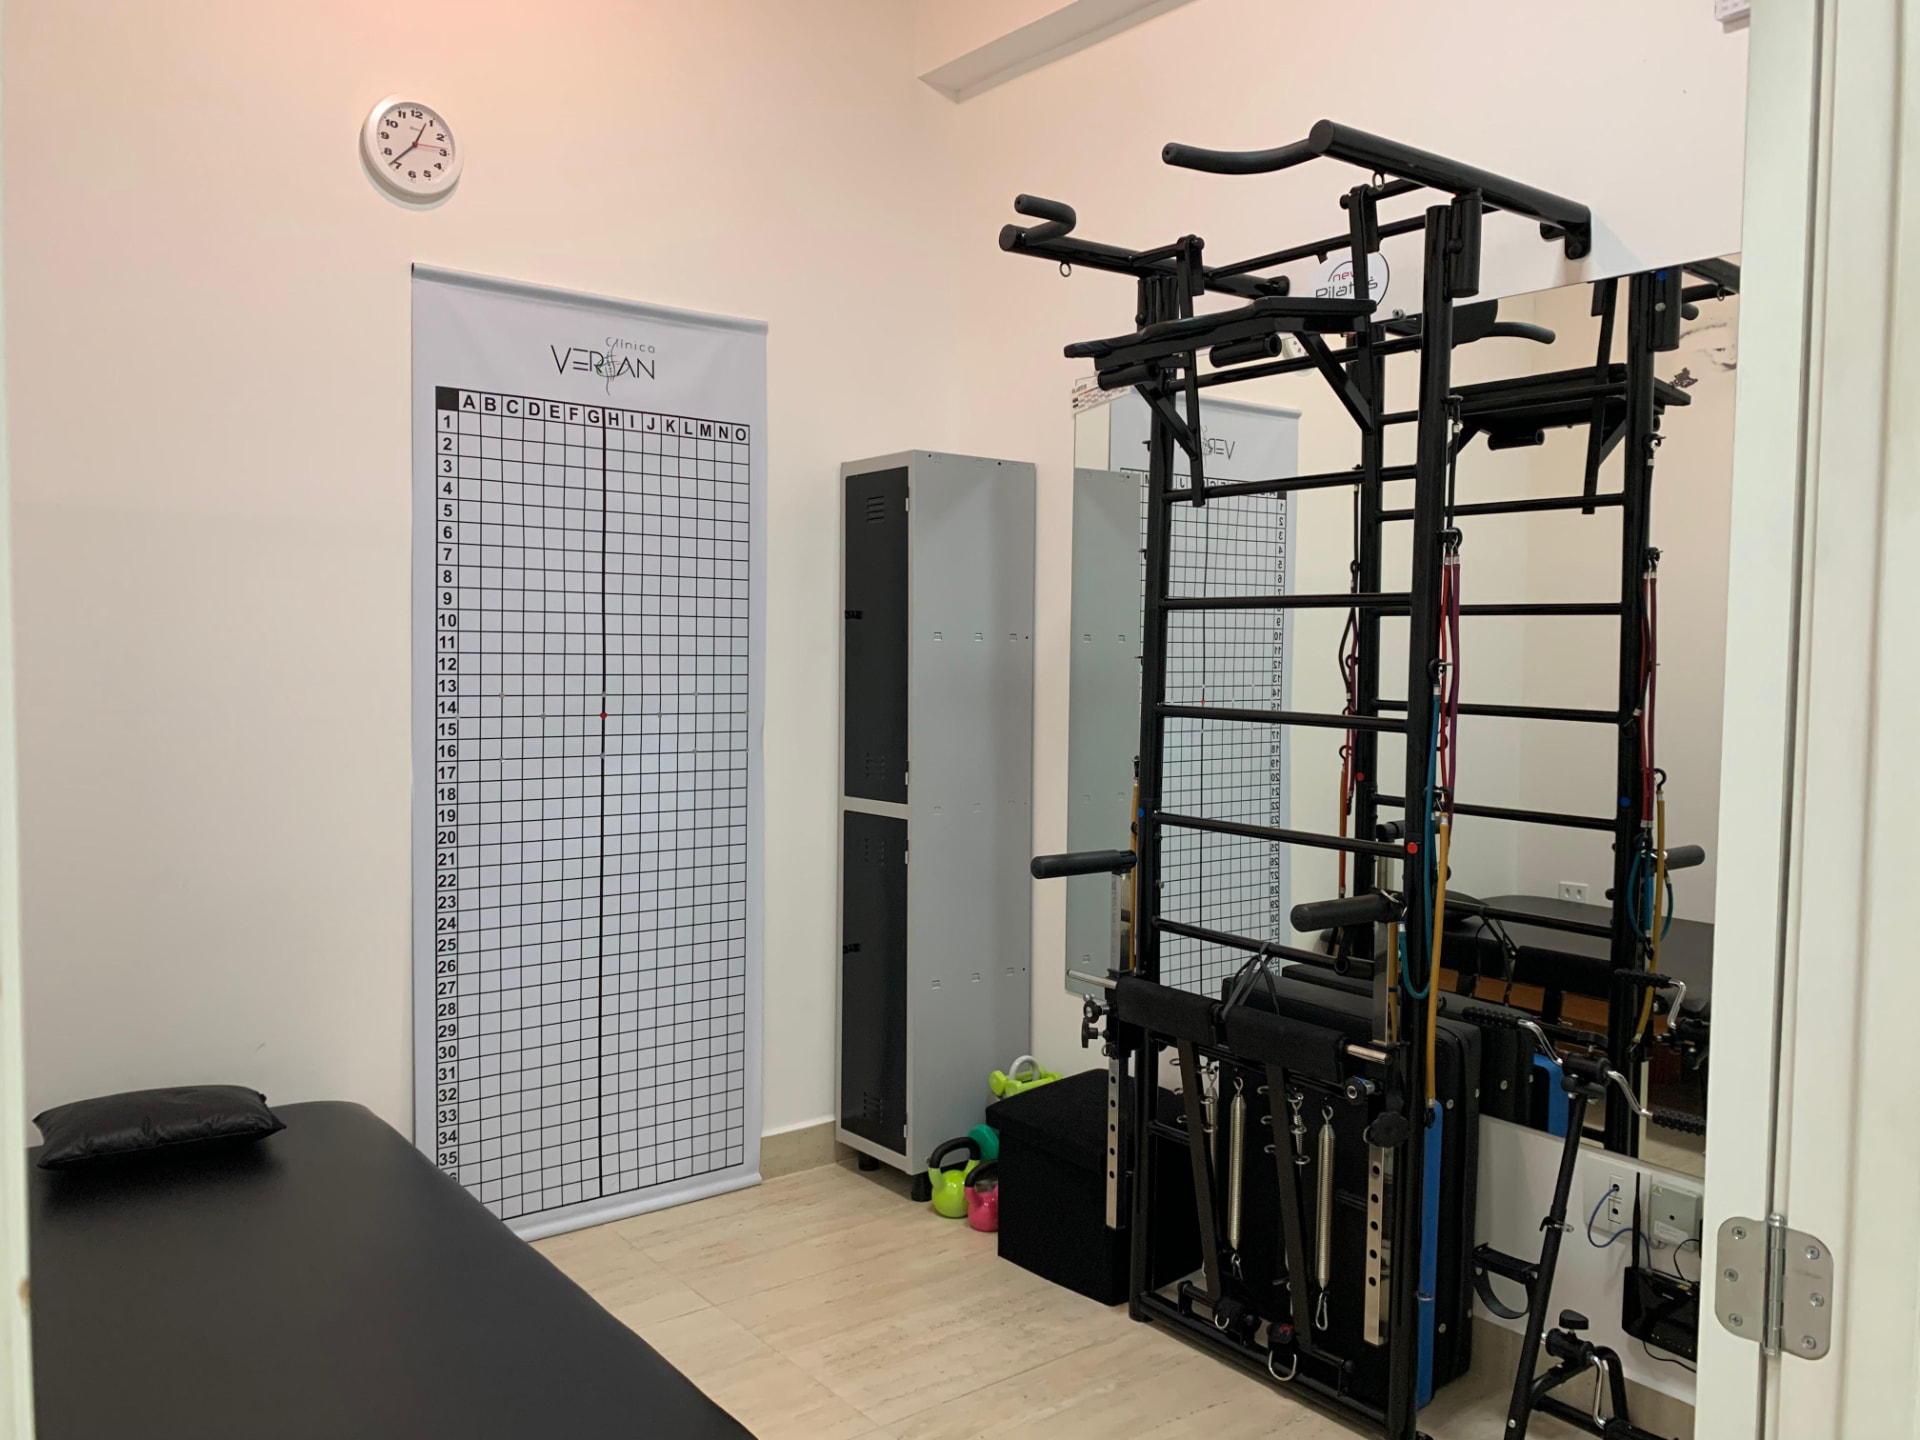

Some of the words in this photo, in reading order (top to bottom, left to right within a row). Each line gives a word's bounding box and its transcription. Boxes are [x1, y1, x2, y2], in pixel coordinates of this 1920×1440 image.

[398, 110, 406, 120] 11
[410, 109, 424, 120] 12
[385, 119, 398, 128] 10
[428, 120, 434, 128] 1
[380, 131, 390, 140] 9
[436, 133, 445, 142] 2
[384, 148, 392, 156] 8
[438, 148, 447, 157] 3
[394, 160, 402, 170] 7
[434, 162, 442, 170] 4
[408, 170, 416, 178] 6
[423, 170, 432, 178] 5
[1315, 278, 1378, 298] Pilats
[443, 414, 451, 429] 1
[462, 394, 476, 410] A
[484, 396, 497, 412] B
[506, 399, 519, 414] C
[528, 401, 541, 416] D
[549, 404, 561, 419] E
[569, 407, 579, 421] F
[587, 409, 600, 424] G
[608, 412, 619, 427] H
[646, 417, 655, 431] J
[666, 419, 676, 433] K
[684, 421, 693, 436] L
[700, 423, 712, 438] M
[718, 425, 729, 440] N
[735, 427, 747, 442] O
[442, 437, 453, 451] 2
[443, 459, 453, 473] 3
[442, 481, 453, 495] 4
[443, 503, 453, 518] 5
[443, 525, 453, 540] 6
[443, 547, 453, 561] 7
[443, 569, 453, 584] 8
[442, 591, 453, 606] 9
[437, 613, 457, 628] 10
[437, 635, 455, 649] 11
[437, 657, 457, 671] 12
[437, 679, 457, 693] 13
[437, 700, 457, 715] 14
[437, 722, 457, 736] 15
[437, 744, 457, 758] 16
[437, 765, 457, 780] 17
[437, 787, 457, 801] 18
[437, 808, 456, 823] 19
[437, 830, 456, 845] 20
[437, 851, 455, 867] 21
[437, 873, 457, 888] 22
[437, 895, 457, 910] 23
[437, 916, 457, 931] 24
[437, 937, 457, 953] 25
[437, 959, 457, 974] 26
[437, 980, 457, 996] 27
[437, 1002, 457, 1017] 28
[437, 1023, 457, 1039] 29
[437, 1044, 457, 1060] 30
[437, 1065, 455, 1081] 31
[437, 1087, 457, 1103] 32
[437, 1108, 457, 1124] 33
[437, 1129, 458, 1145] 34
[437, 1150, 458, 1167] 35
